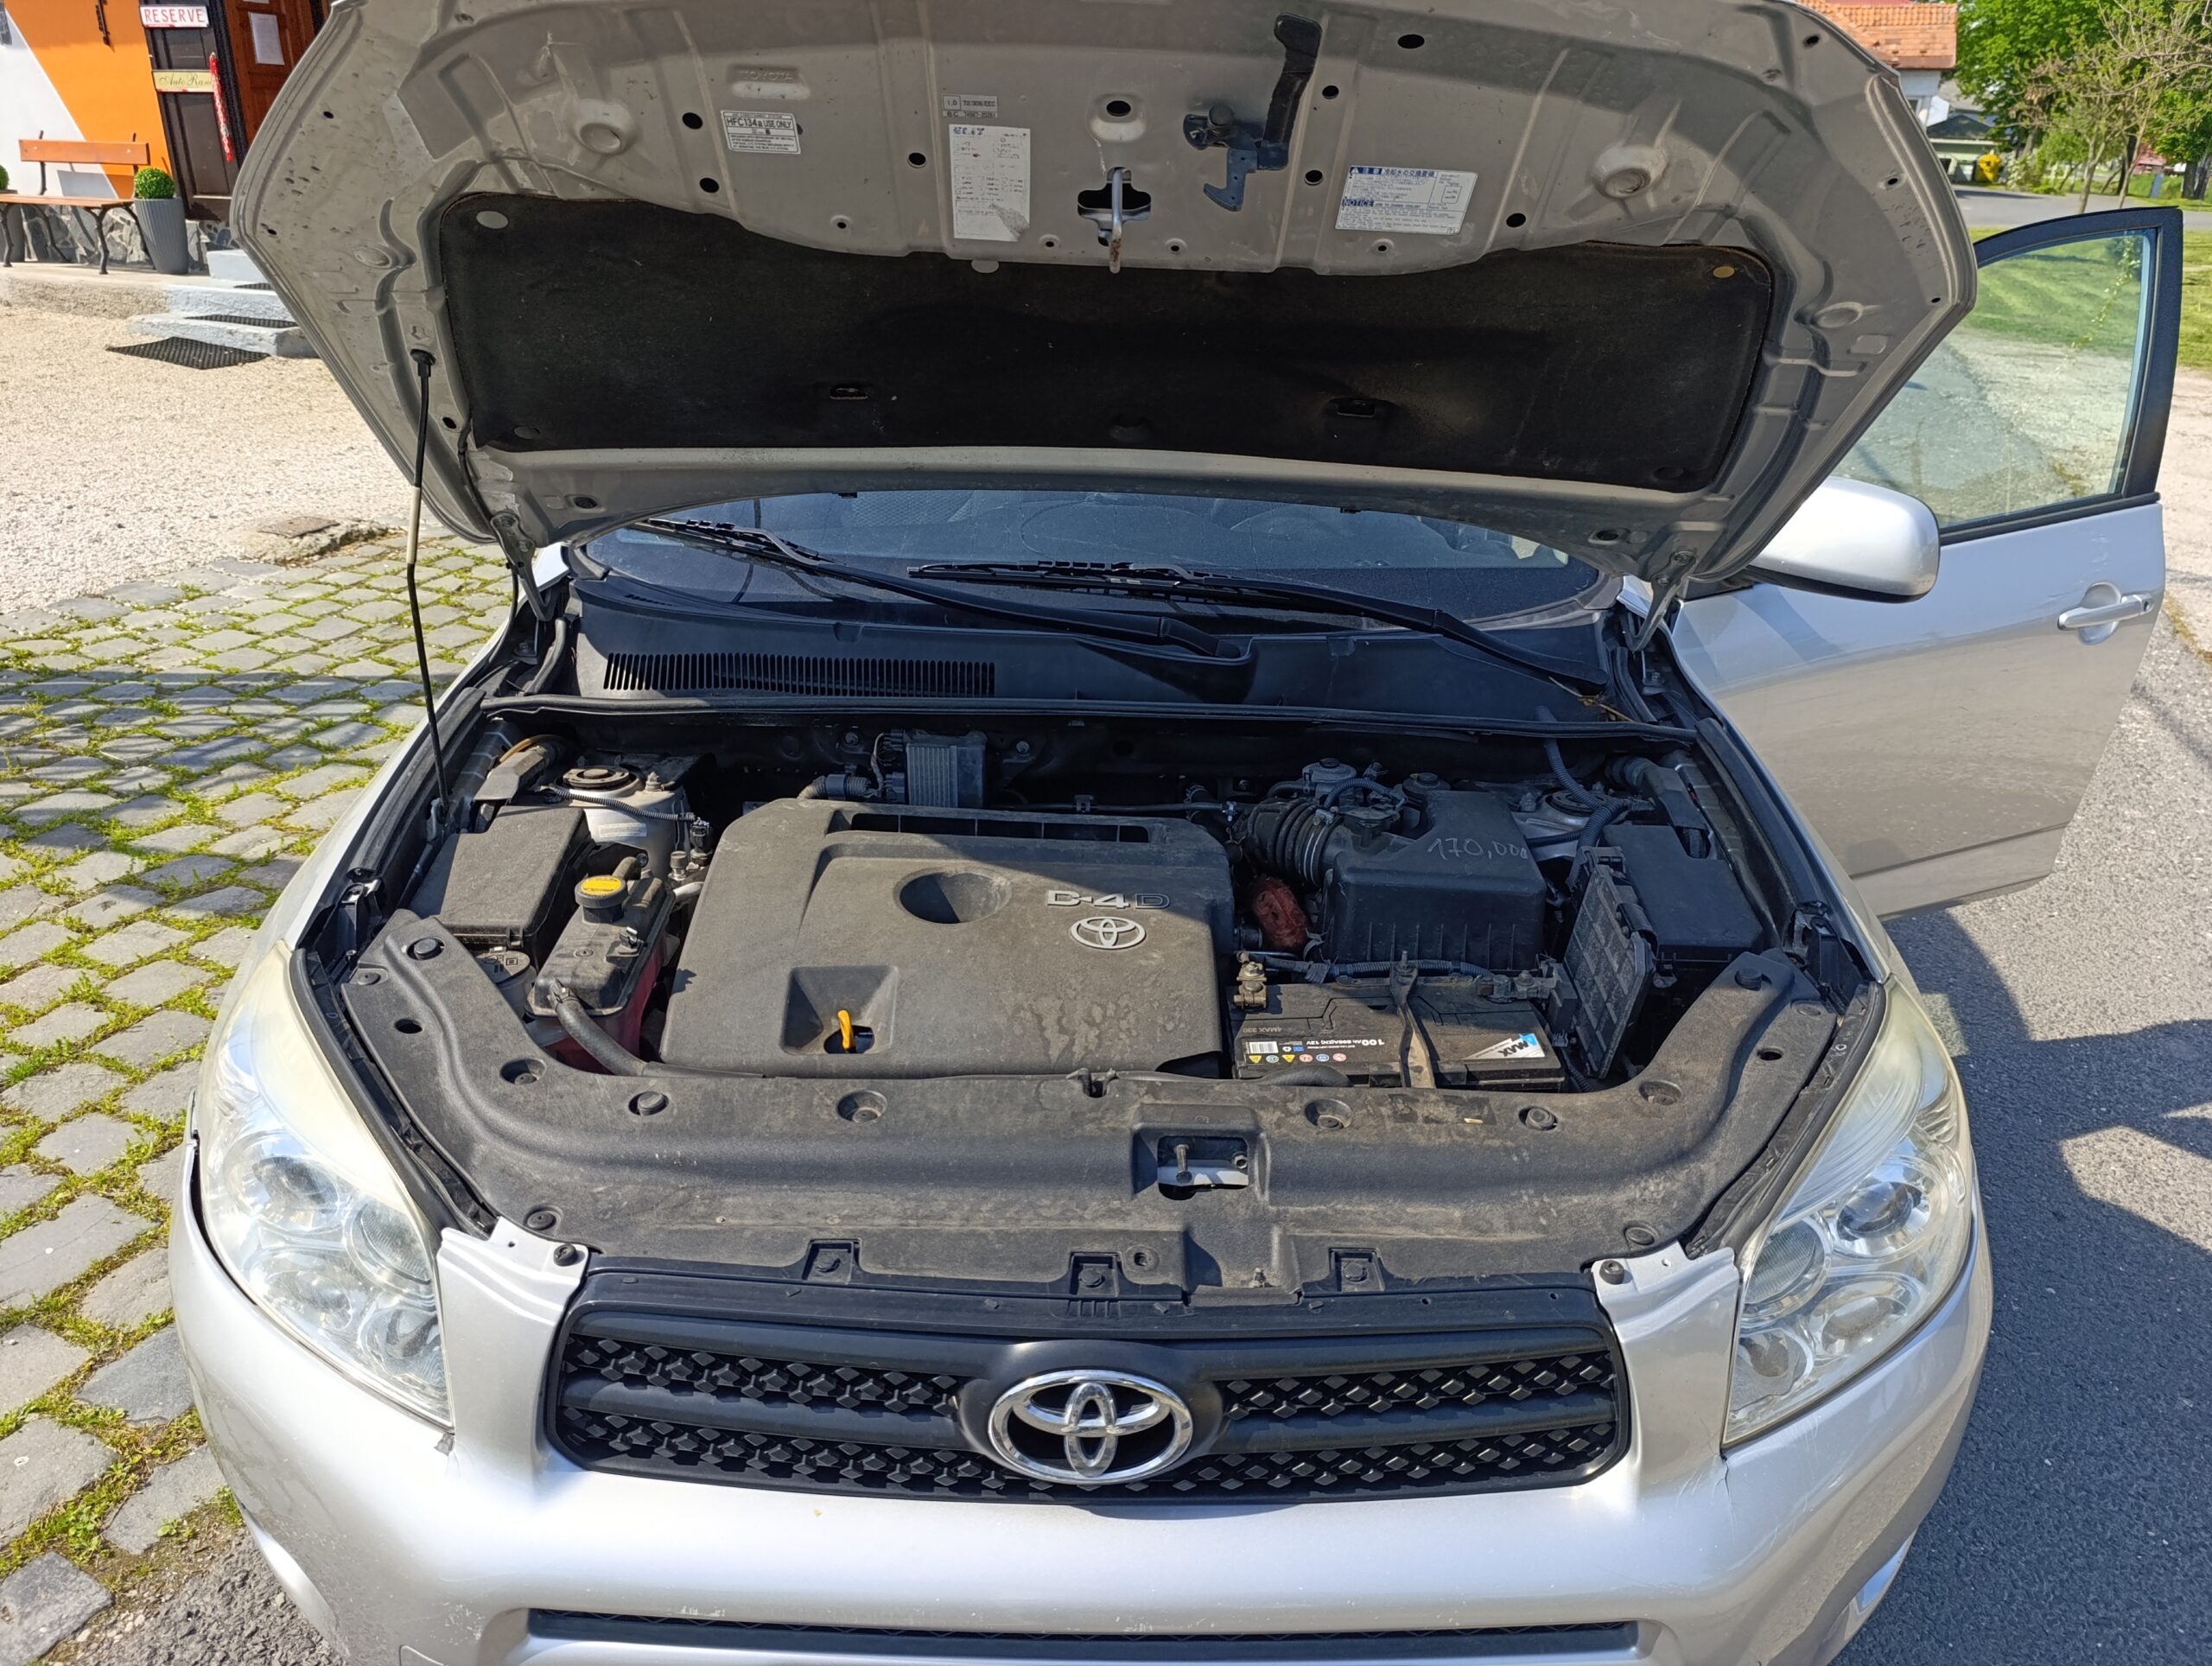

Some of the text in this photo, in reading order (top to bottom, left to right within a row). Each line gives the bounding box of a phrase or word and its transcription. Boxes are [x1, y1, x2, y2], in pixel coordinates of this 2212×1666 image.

[144, 9, 205, 22] RESERVE
[158, 73, 185, 86] Auto
[727, 118, 791, 129] HFC134a USE ONLY
[1047, 889, 1171, 909] D-4D
